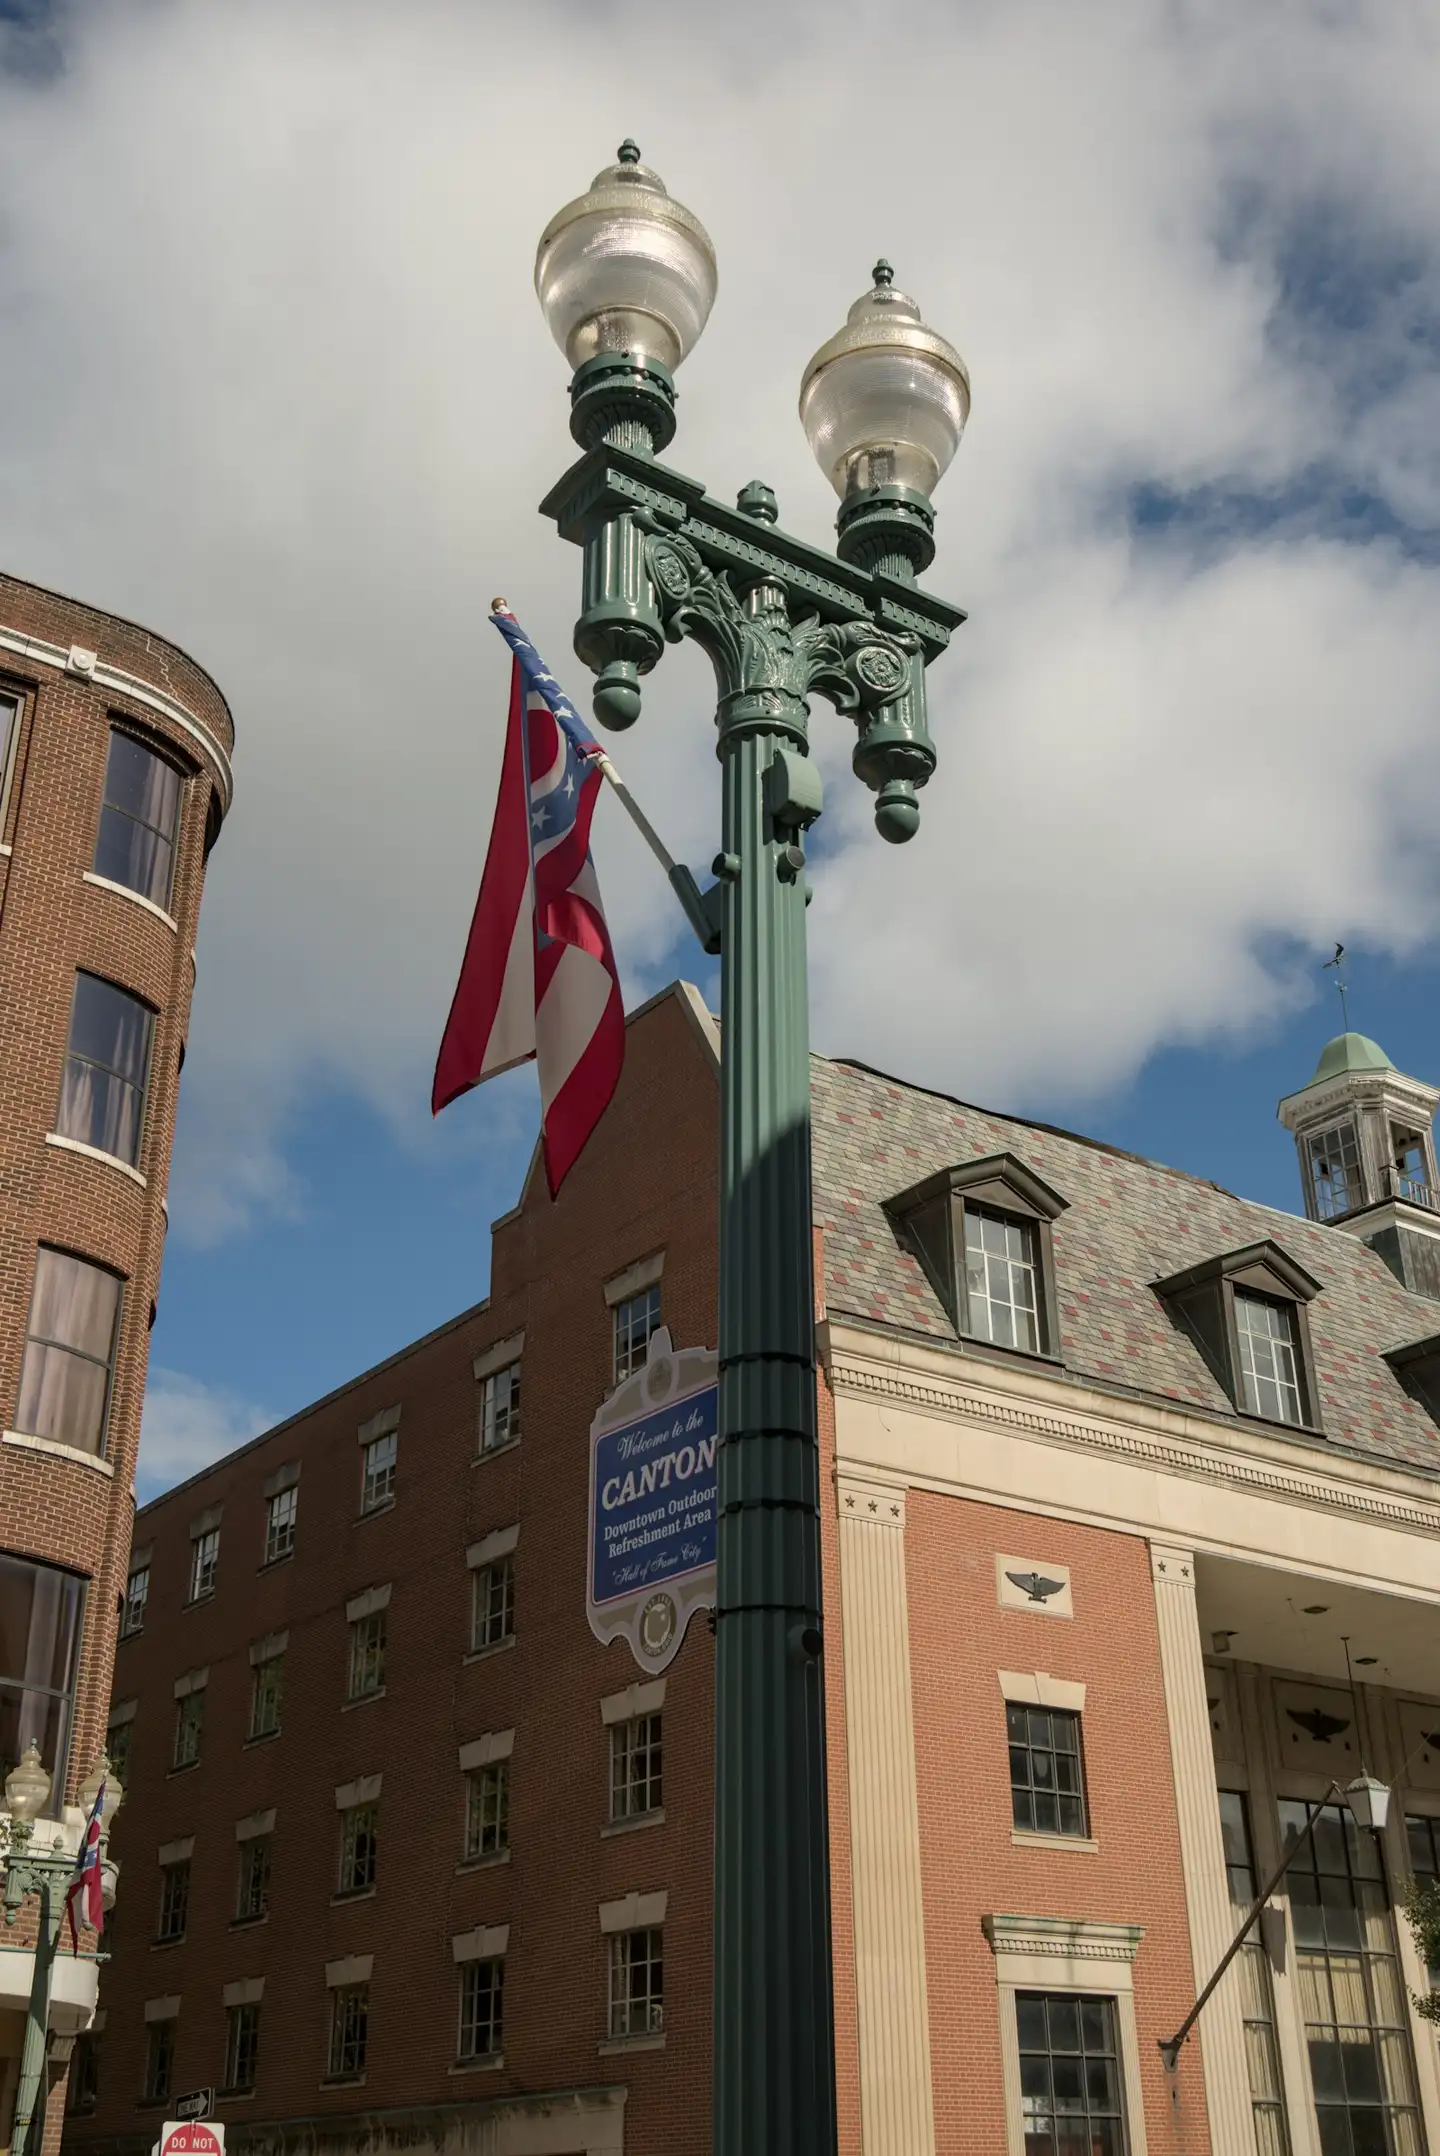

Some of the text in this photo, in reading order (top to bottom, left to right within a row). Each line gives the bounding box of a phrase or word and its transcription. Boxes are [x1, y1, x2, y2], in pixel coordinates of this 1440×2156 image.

[618, 1408, 704, 1461] Welcome to the
[602, 1434, 718, 1511] CANTON
[604, 1485, 718, 1541] Downtown Outdoor
[608, 1508, 712, 1558] Refreshment Area
[640, 1558, 651, 1582] of
[651, 1551, 679, 1573] Fame
[171, 2137, 214, 2149] DO NOT
